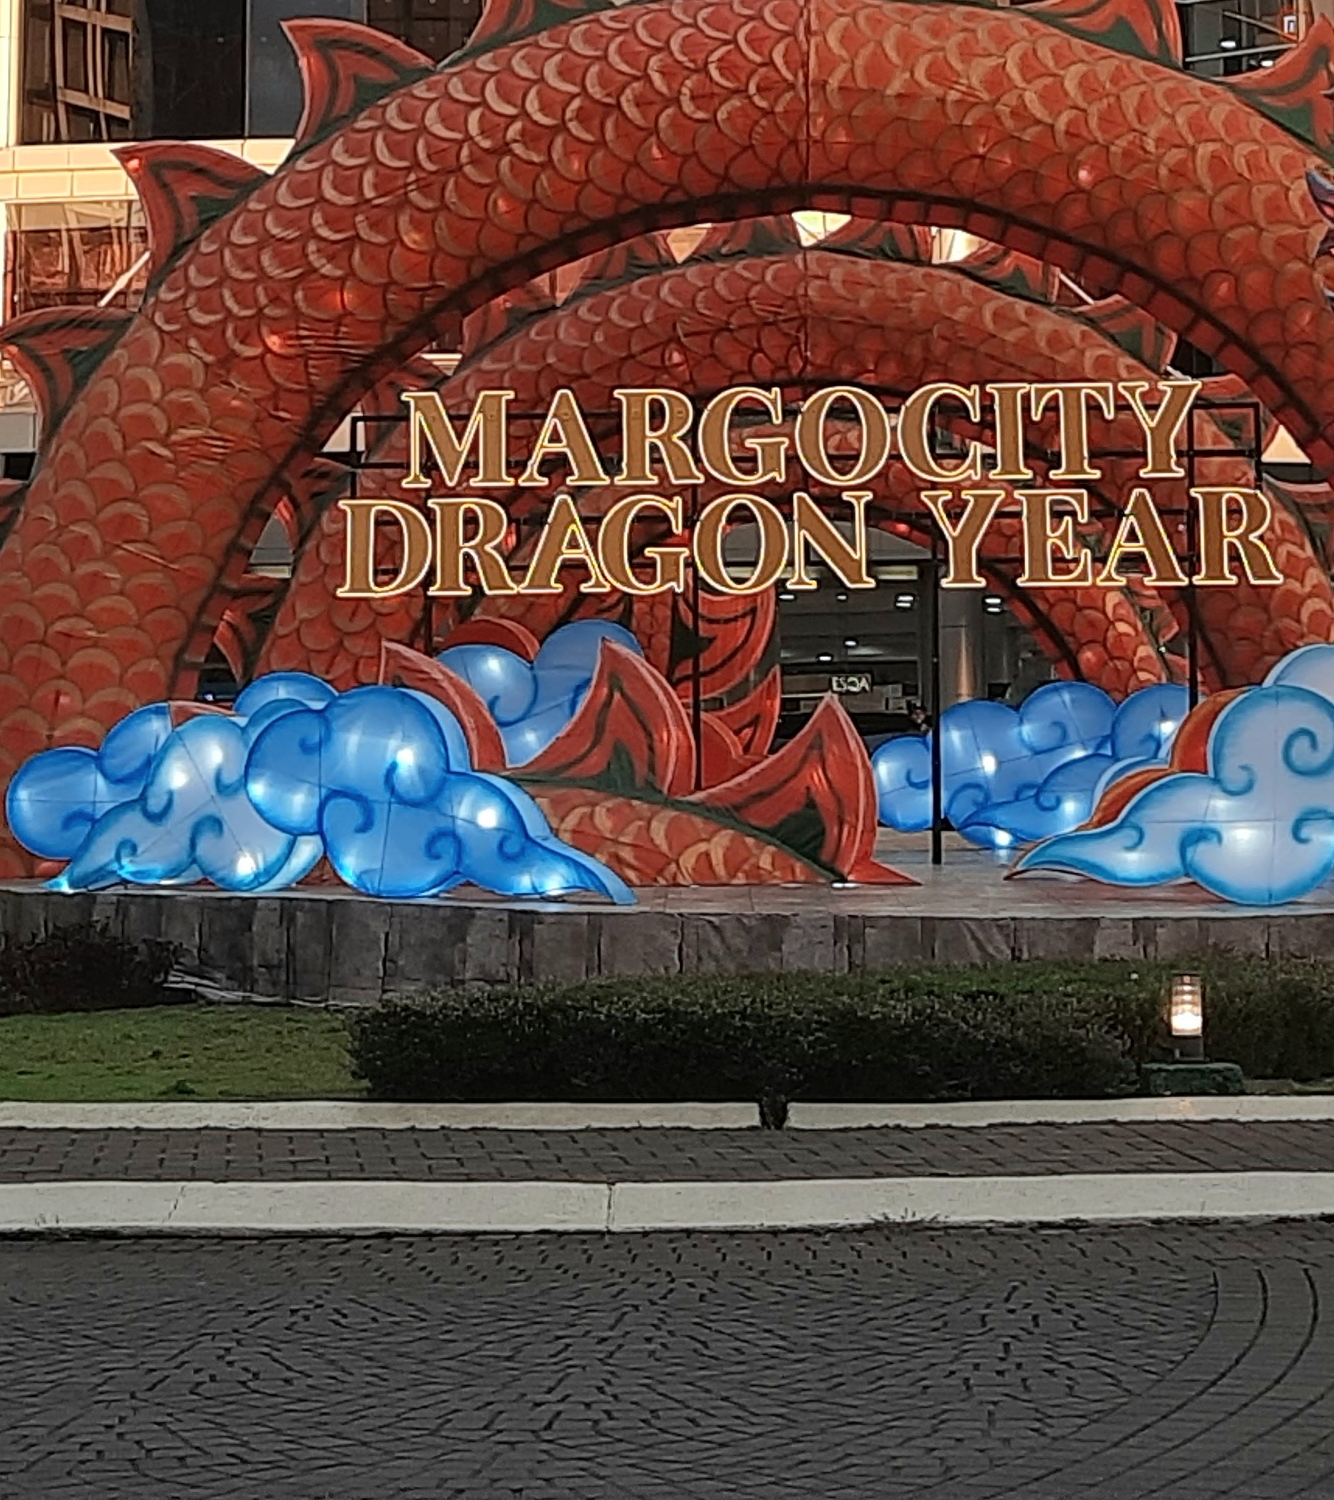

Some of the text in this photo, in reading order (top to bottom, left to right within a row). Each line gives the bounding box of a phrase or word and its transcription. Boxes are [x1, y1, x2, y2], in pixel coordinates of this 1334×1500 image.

[402, 380, 1202, 488] MARGOCITY
[336, 487, 1284, 597] DRAGON YEAR
